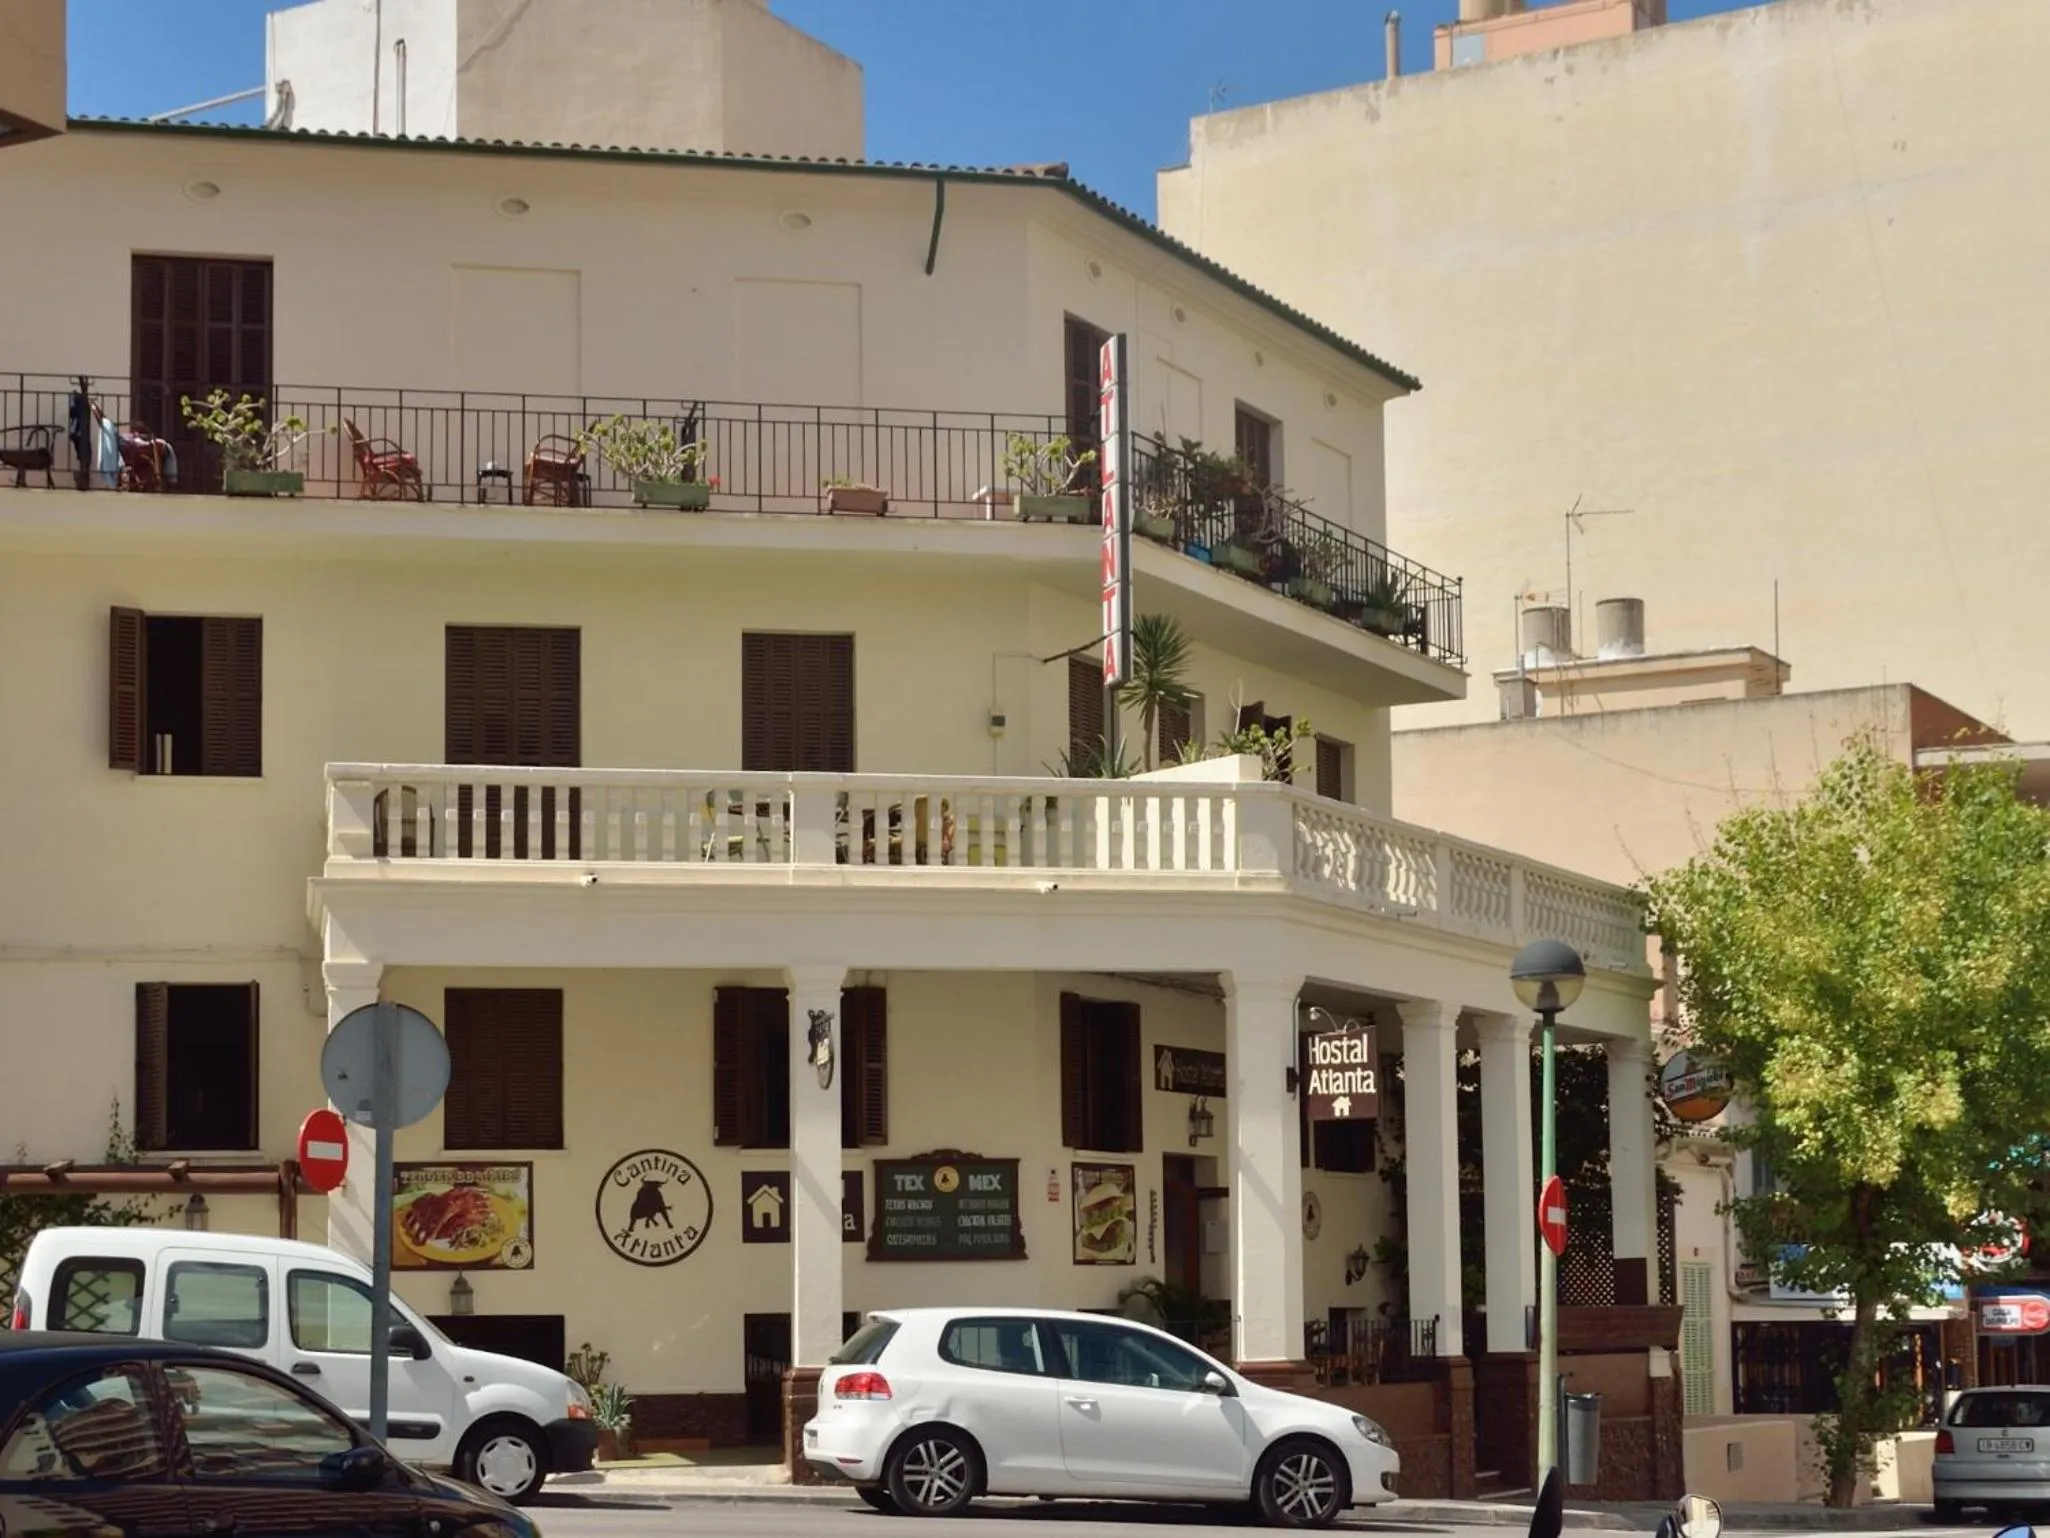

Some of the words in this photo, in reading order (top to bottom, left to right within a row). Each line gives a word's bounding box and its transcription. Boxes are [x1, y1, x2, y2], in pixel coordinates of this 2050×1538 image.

[1099, 342, 1117, 686] ATLANTA
[1308, 1033, 1368, 1065] Hostal
[1308, 1066, 1377, 1095] Atlanta
[613, 1155, 692, 1187] Cantina
[893, 1174, 926, 1191] TEX
[968, 1174, 1002, 1191] MEX
[613, 1226, 699, 1258] Atlanta
